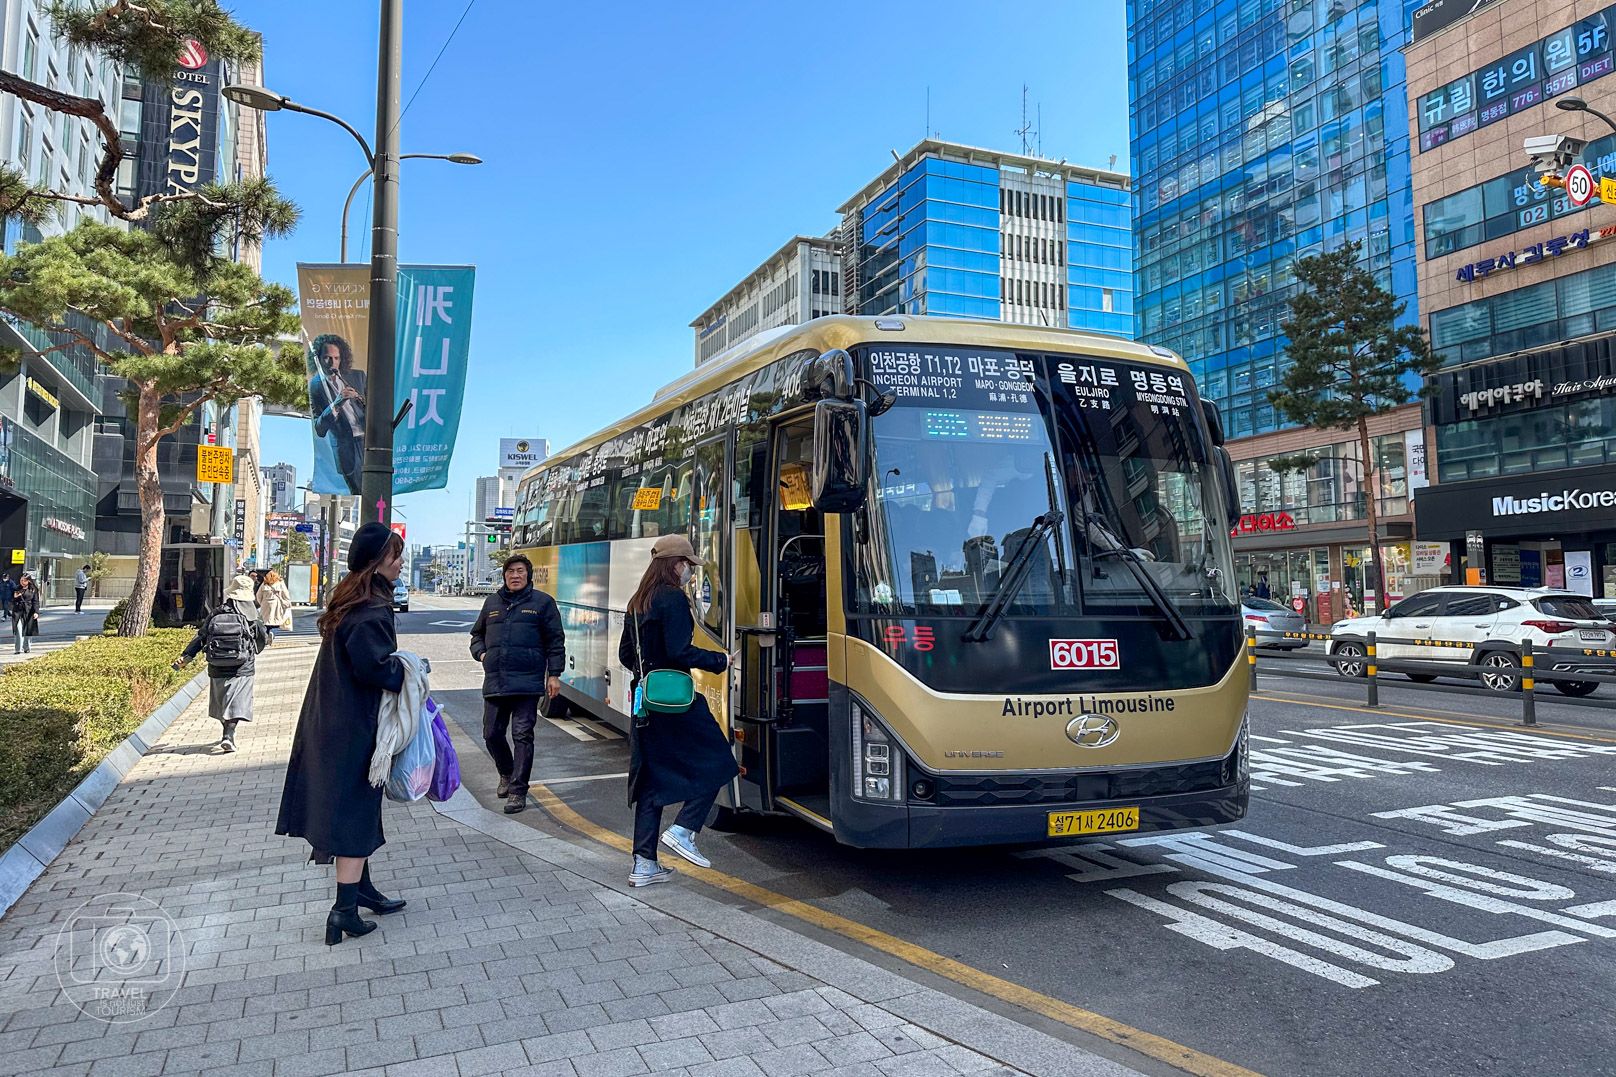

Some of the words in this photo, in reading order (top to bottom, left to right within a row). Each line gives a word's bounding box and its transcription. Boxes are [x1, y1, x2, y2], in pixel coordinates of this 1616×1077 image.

[1415, 5, 1433, 19] Clinic
[1583, 57, 1611, 78] DIET
[1571, 176, 1587, 195] 50
[871, 352, 921, 375] 인천공항
[925, 355, 962, 376] T1,T2
[873, 375, 918, 386] INCHEON
[921, 377, 962, 388] AIRPORT
[1057, 363, 1119, 387] 을지로
[1130, 370, 1185, 397] 명동역
[890, 386, 940, 398] TERMINAL
[1075, 386, 1110, 398] EULJIRO
[1551, 382, 1581, 395] Hair
[1136, 392, 1177, 405] MYEONGDONG
[507, 453, 538, 461] KISWEL
[1240, 511, 1295, 532] 다이소
[884, 625, 936, 651] 우등
[1053, 641, 1117, 667] 6015
[1002, 697, 1073, 718] Airport
[1079, 695, 1176, 716] Limousine
[944, 751, 1004, 759] UNIVERSE
